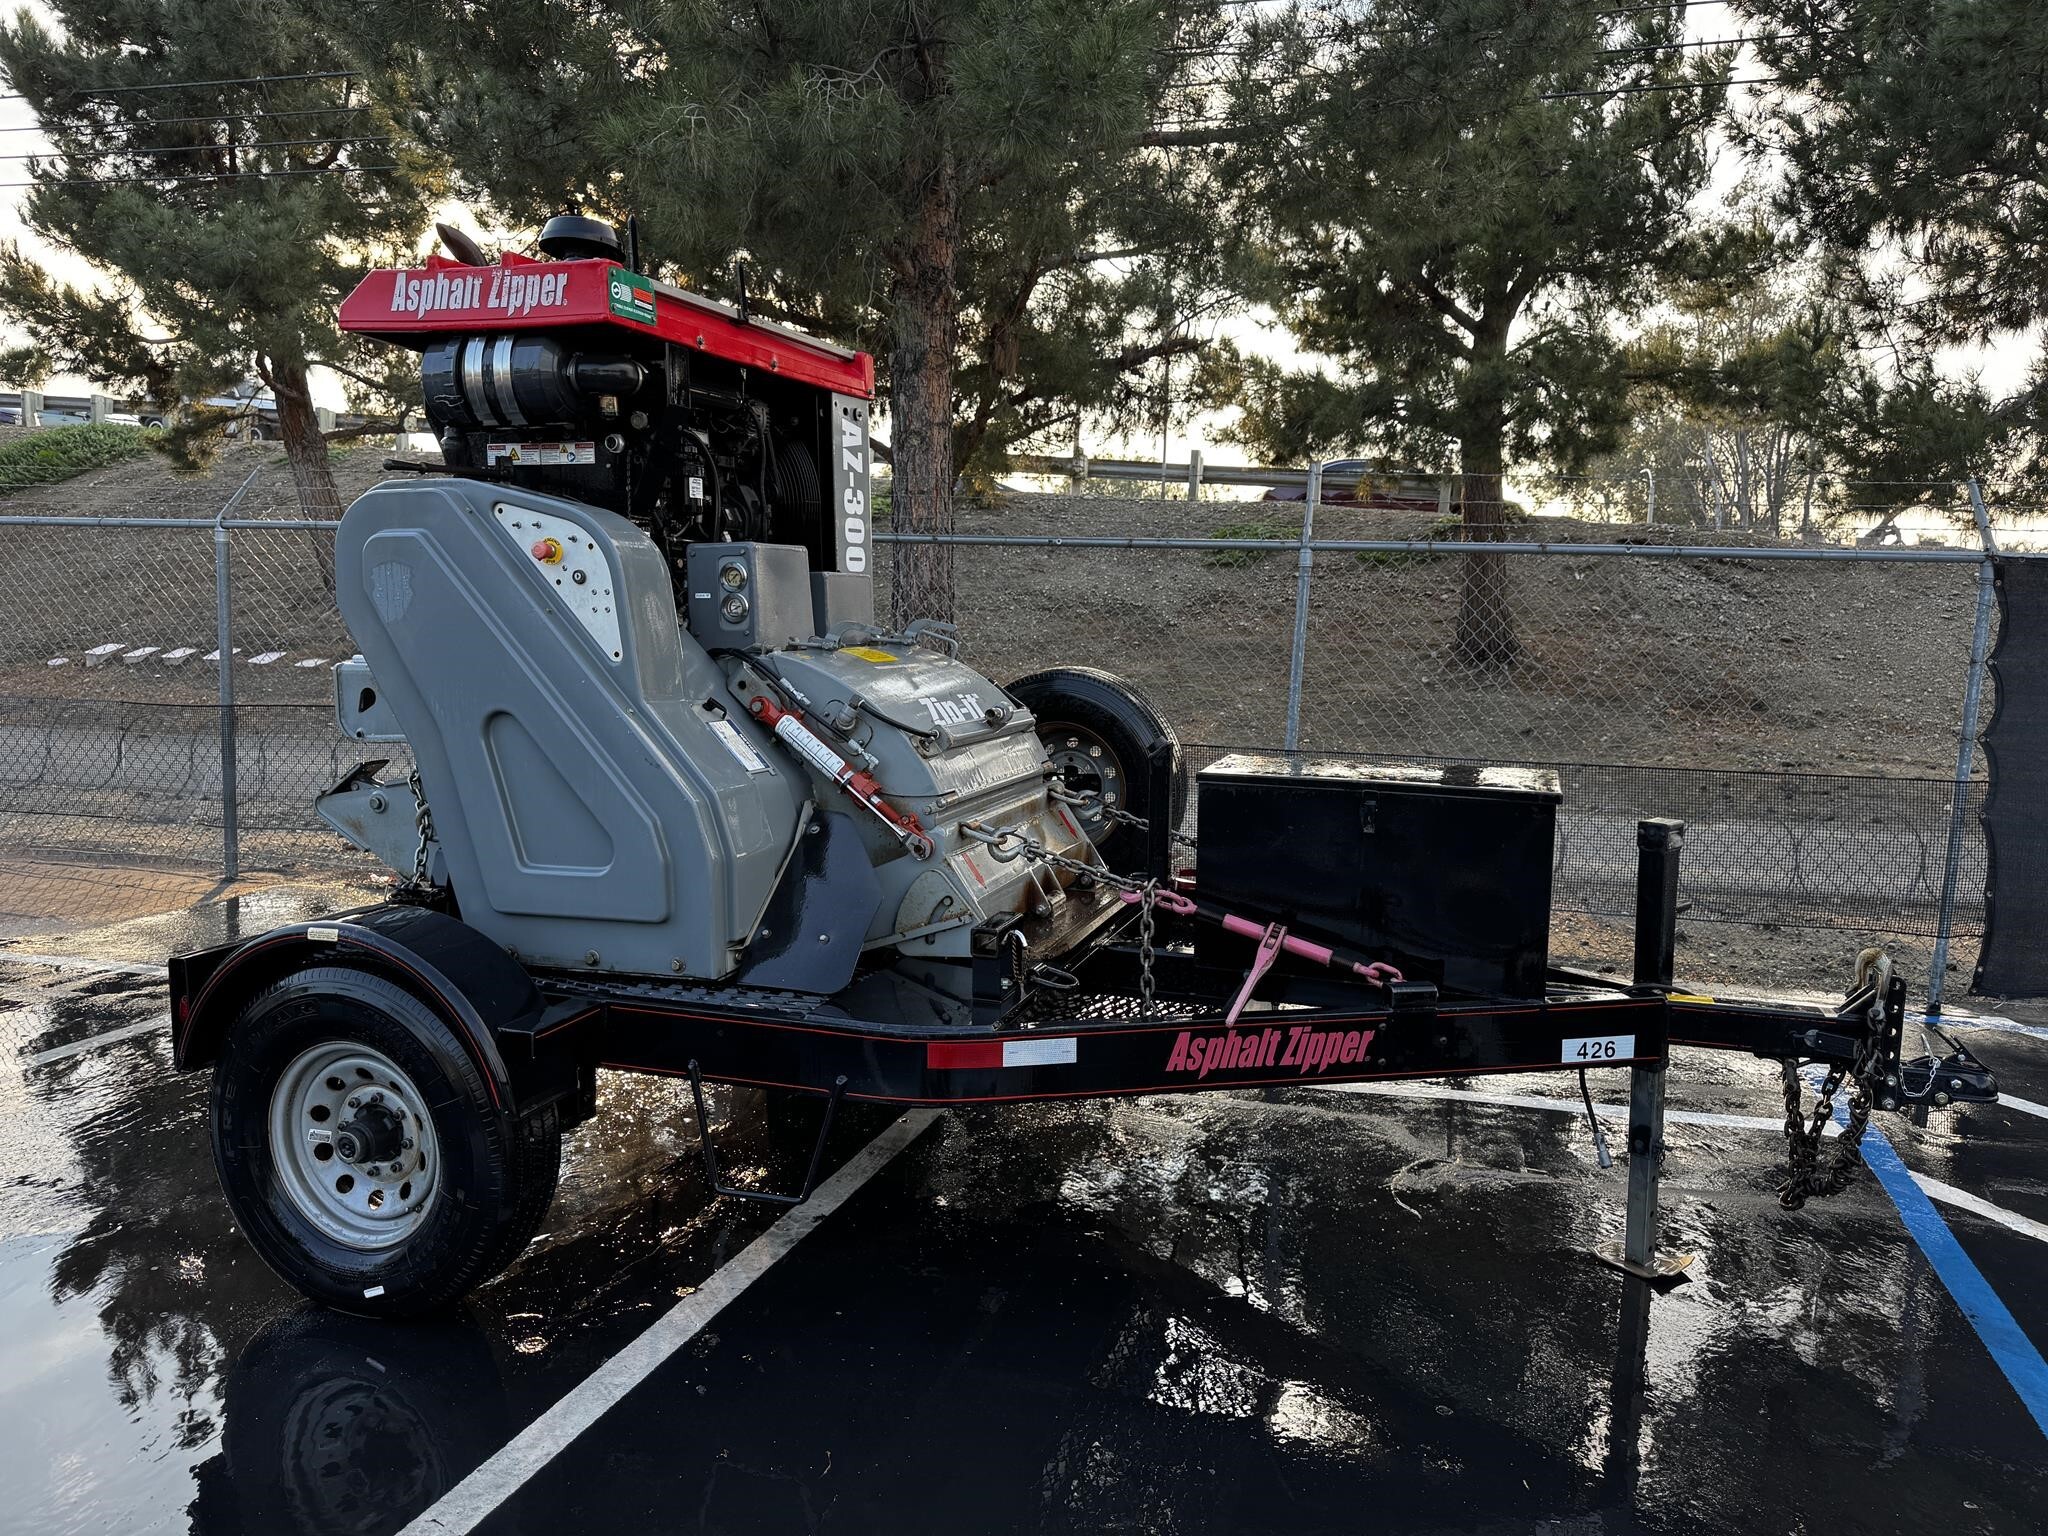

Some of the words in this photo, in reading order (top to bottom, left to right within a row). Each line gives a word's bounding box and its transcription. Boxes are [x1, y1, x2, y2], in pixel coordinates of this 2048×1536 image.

[391, 272, 482, 319] Asphalt
[488, 269, 567, 317] Zipper
[842, 418, 866, 573] AZ-300
[1165, 1028, 1281, 1079] Asphalt
[1279, 1026, 1375, 1074] Zipper
[1577, 1041, 1616, 1060] 426
